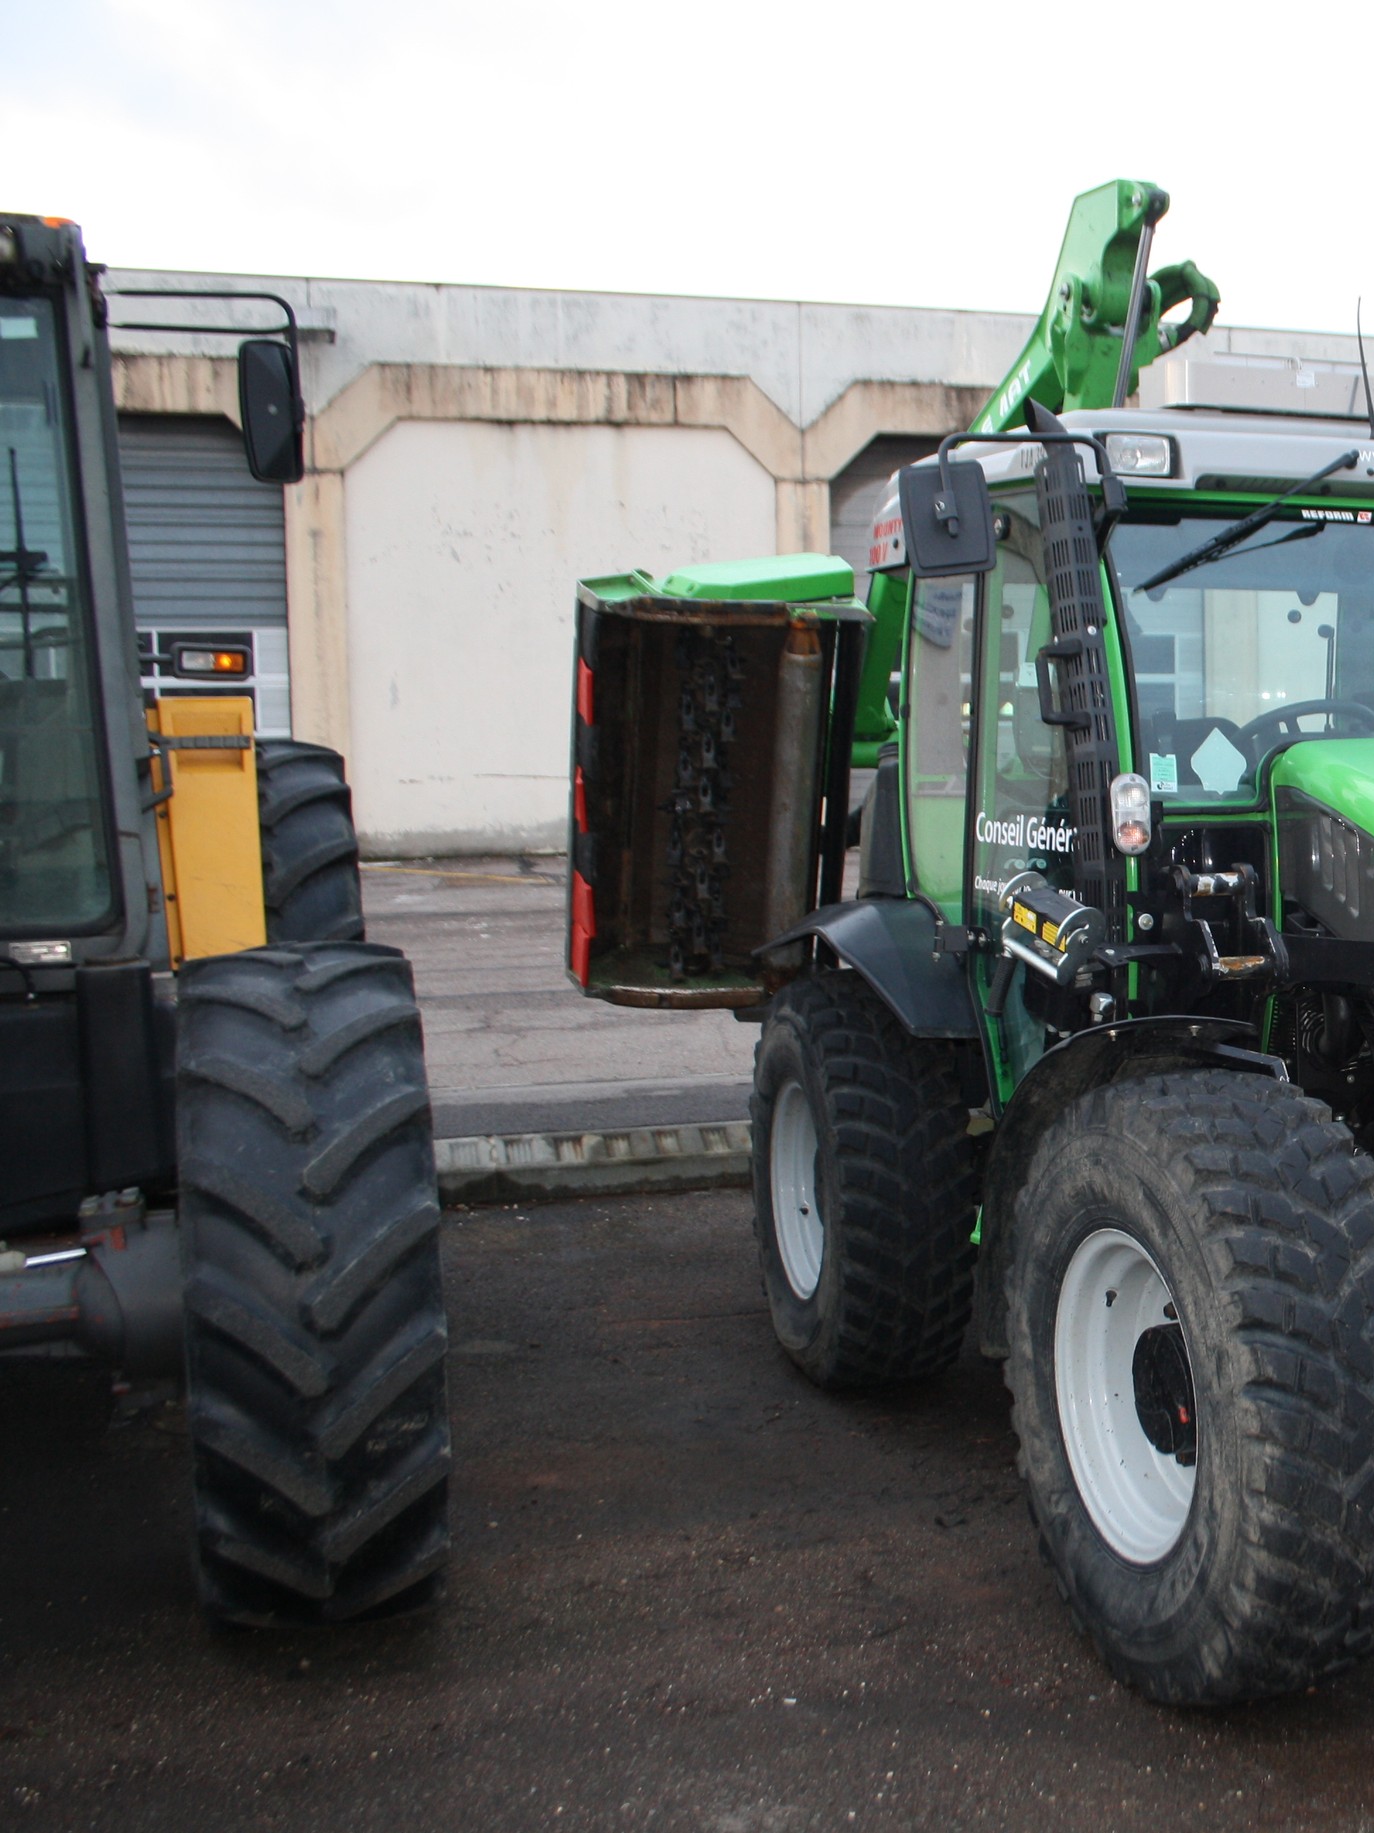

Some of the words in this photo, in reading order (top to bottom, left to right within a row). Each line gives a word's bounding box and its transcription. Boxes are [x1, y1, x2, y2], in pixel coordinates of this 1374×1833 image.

[1301, 508, 1355, 522] REFORM
[976, 811, 1024, 847] Conseil
[1026, 816, 1079, 852] Génér
